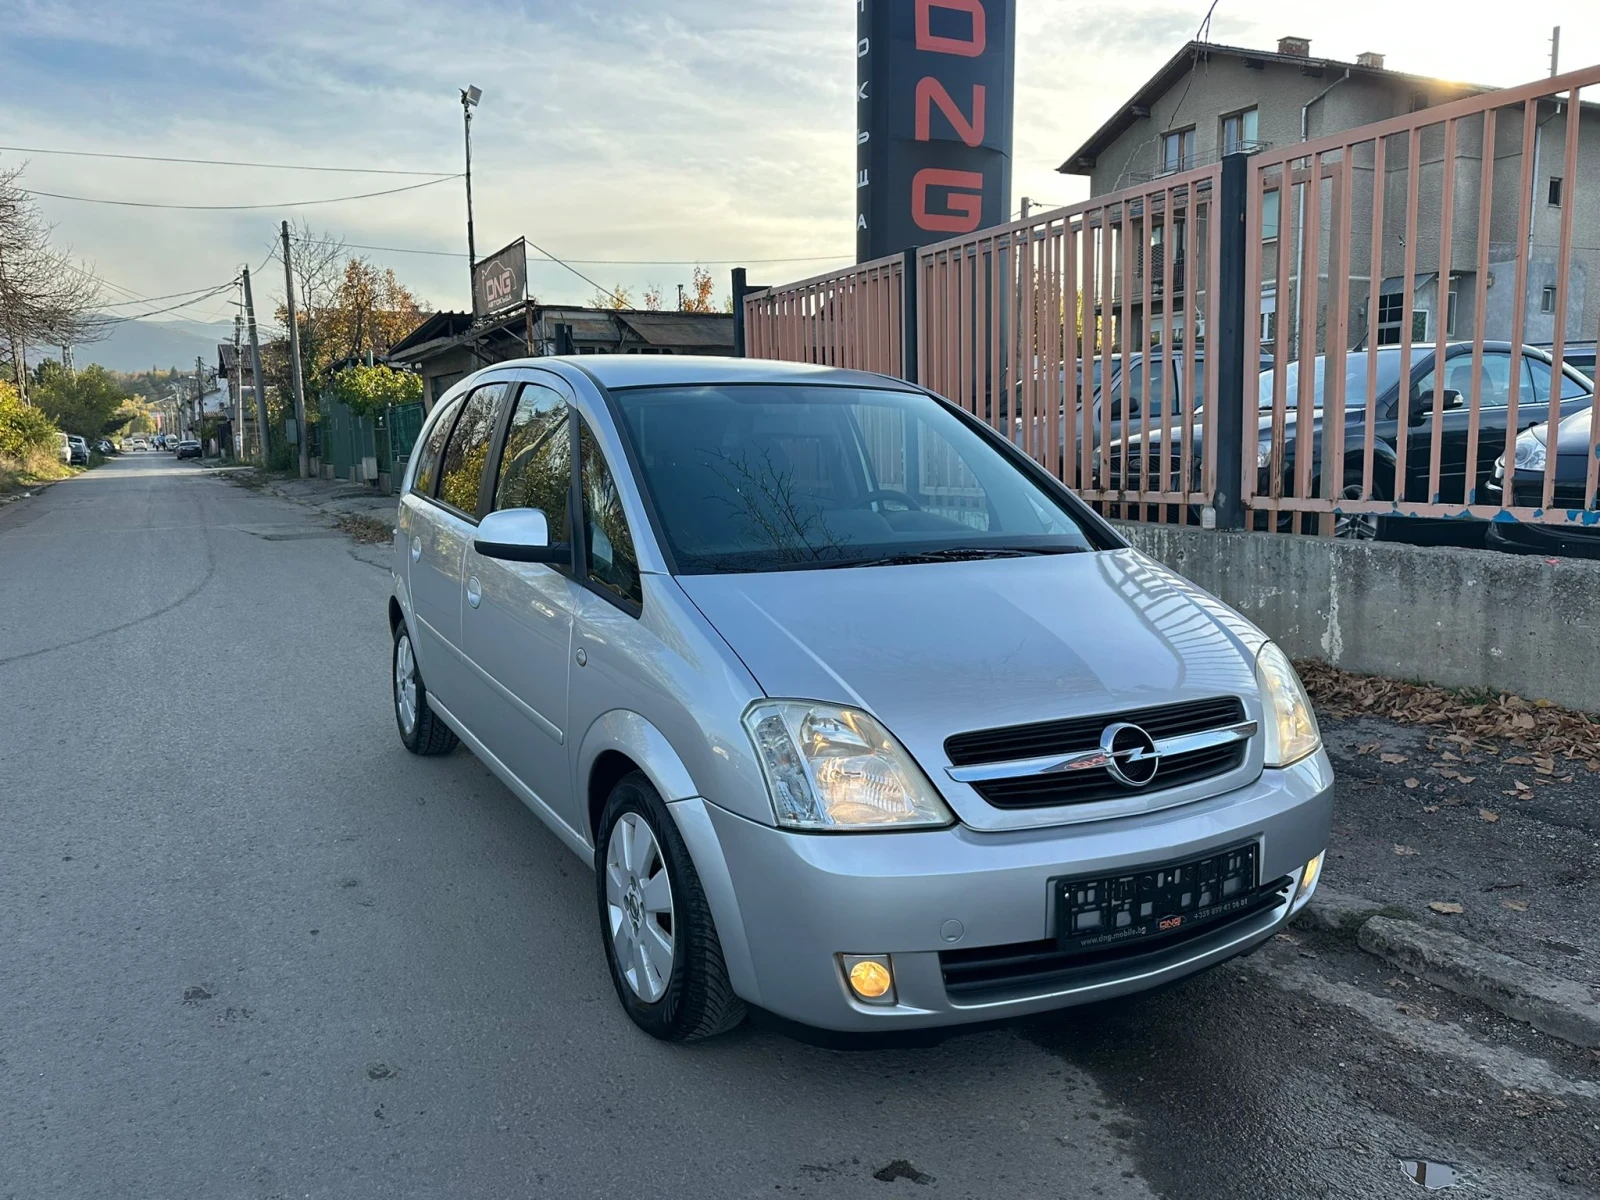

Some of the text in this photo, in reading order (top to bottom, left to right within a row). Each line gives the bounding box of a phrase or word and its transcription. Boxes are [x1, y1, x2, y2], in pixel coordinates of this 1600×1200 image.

[911, 0, 986, 233] DNG
[486, 270, 511, 301] DNG
[1080, 926, 1147, 946] www.dng.mobile.bg
